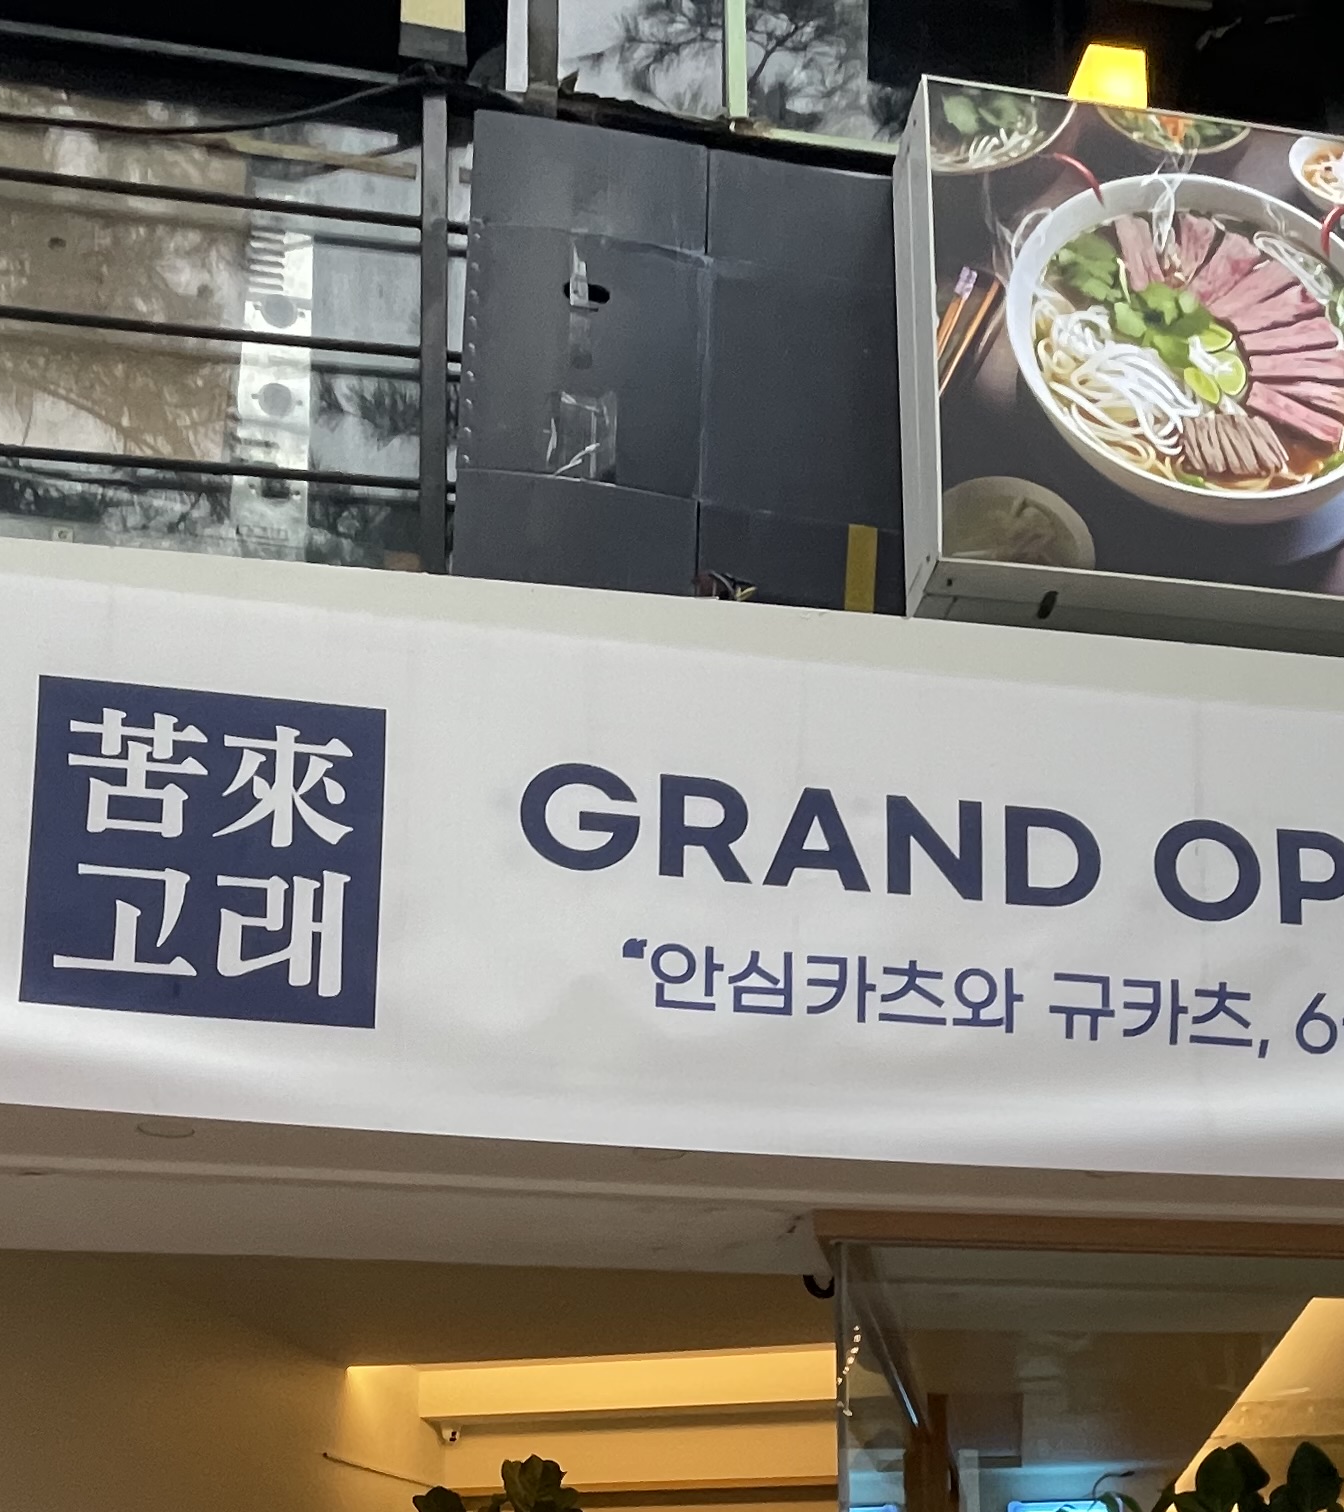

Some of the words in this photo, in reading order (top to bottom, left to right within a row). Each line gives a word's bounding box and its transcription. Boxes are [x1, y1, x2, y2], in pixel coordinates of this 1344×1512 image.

[519, 762, 1102, 908] GRAND
[52, 862, 352, 998] 고래
[1048, 971, 1271, 1060] 규카츠,
